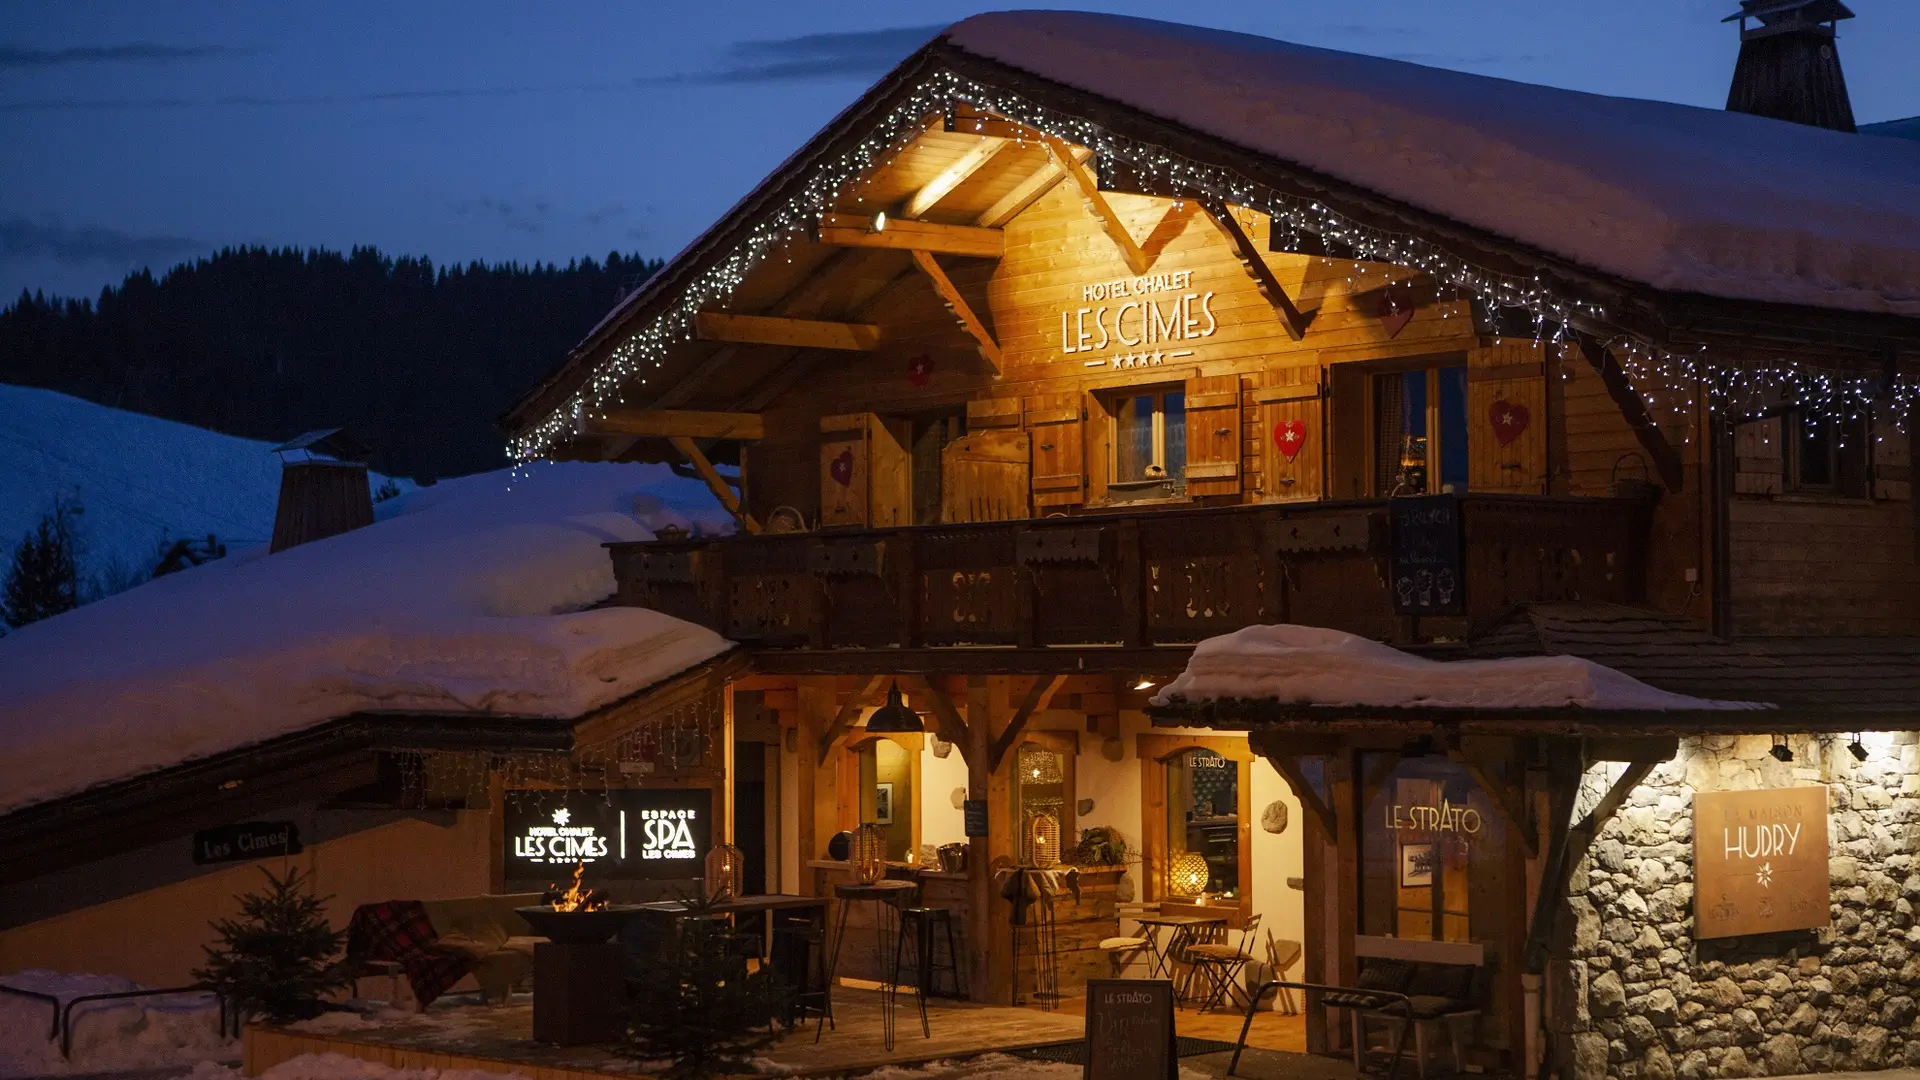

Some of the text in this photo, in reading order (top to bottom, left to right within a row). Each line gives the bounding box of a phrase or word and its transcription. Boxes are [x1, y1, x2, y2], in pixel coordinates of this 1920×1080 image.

[1083, 270, 1193, 302] HOTEL CHALET
[1062, 291, 1218, 354] LES CIMES
[1189, 756, 1225, 768] LE STRATO
[641, 810, 696, 820] ESPACE
[1385, 798, 1481, 833] LE STRATO
[1749, 805, 1803, 821] MAISON
[528, 827, 559, 837] HOTEL
[643, 819, 696, 850] SPA
[1724, 822, 1801, 860] HUDRY
[204, 832, 287, 858] Les Cimes
[515, 836, 608, 857] LES CIMES
[642, 850, 696, 860] LES CIMES
[1104, 990, 1152, 1004] LE STRATO
